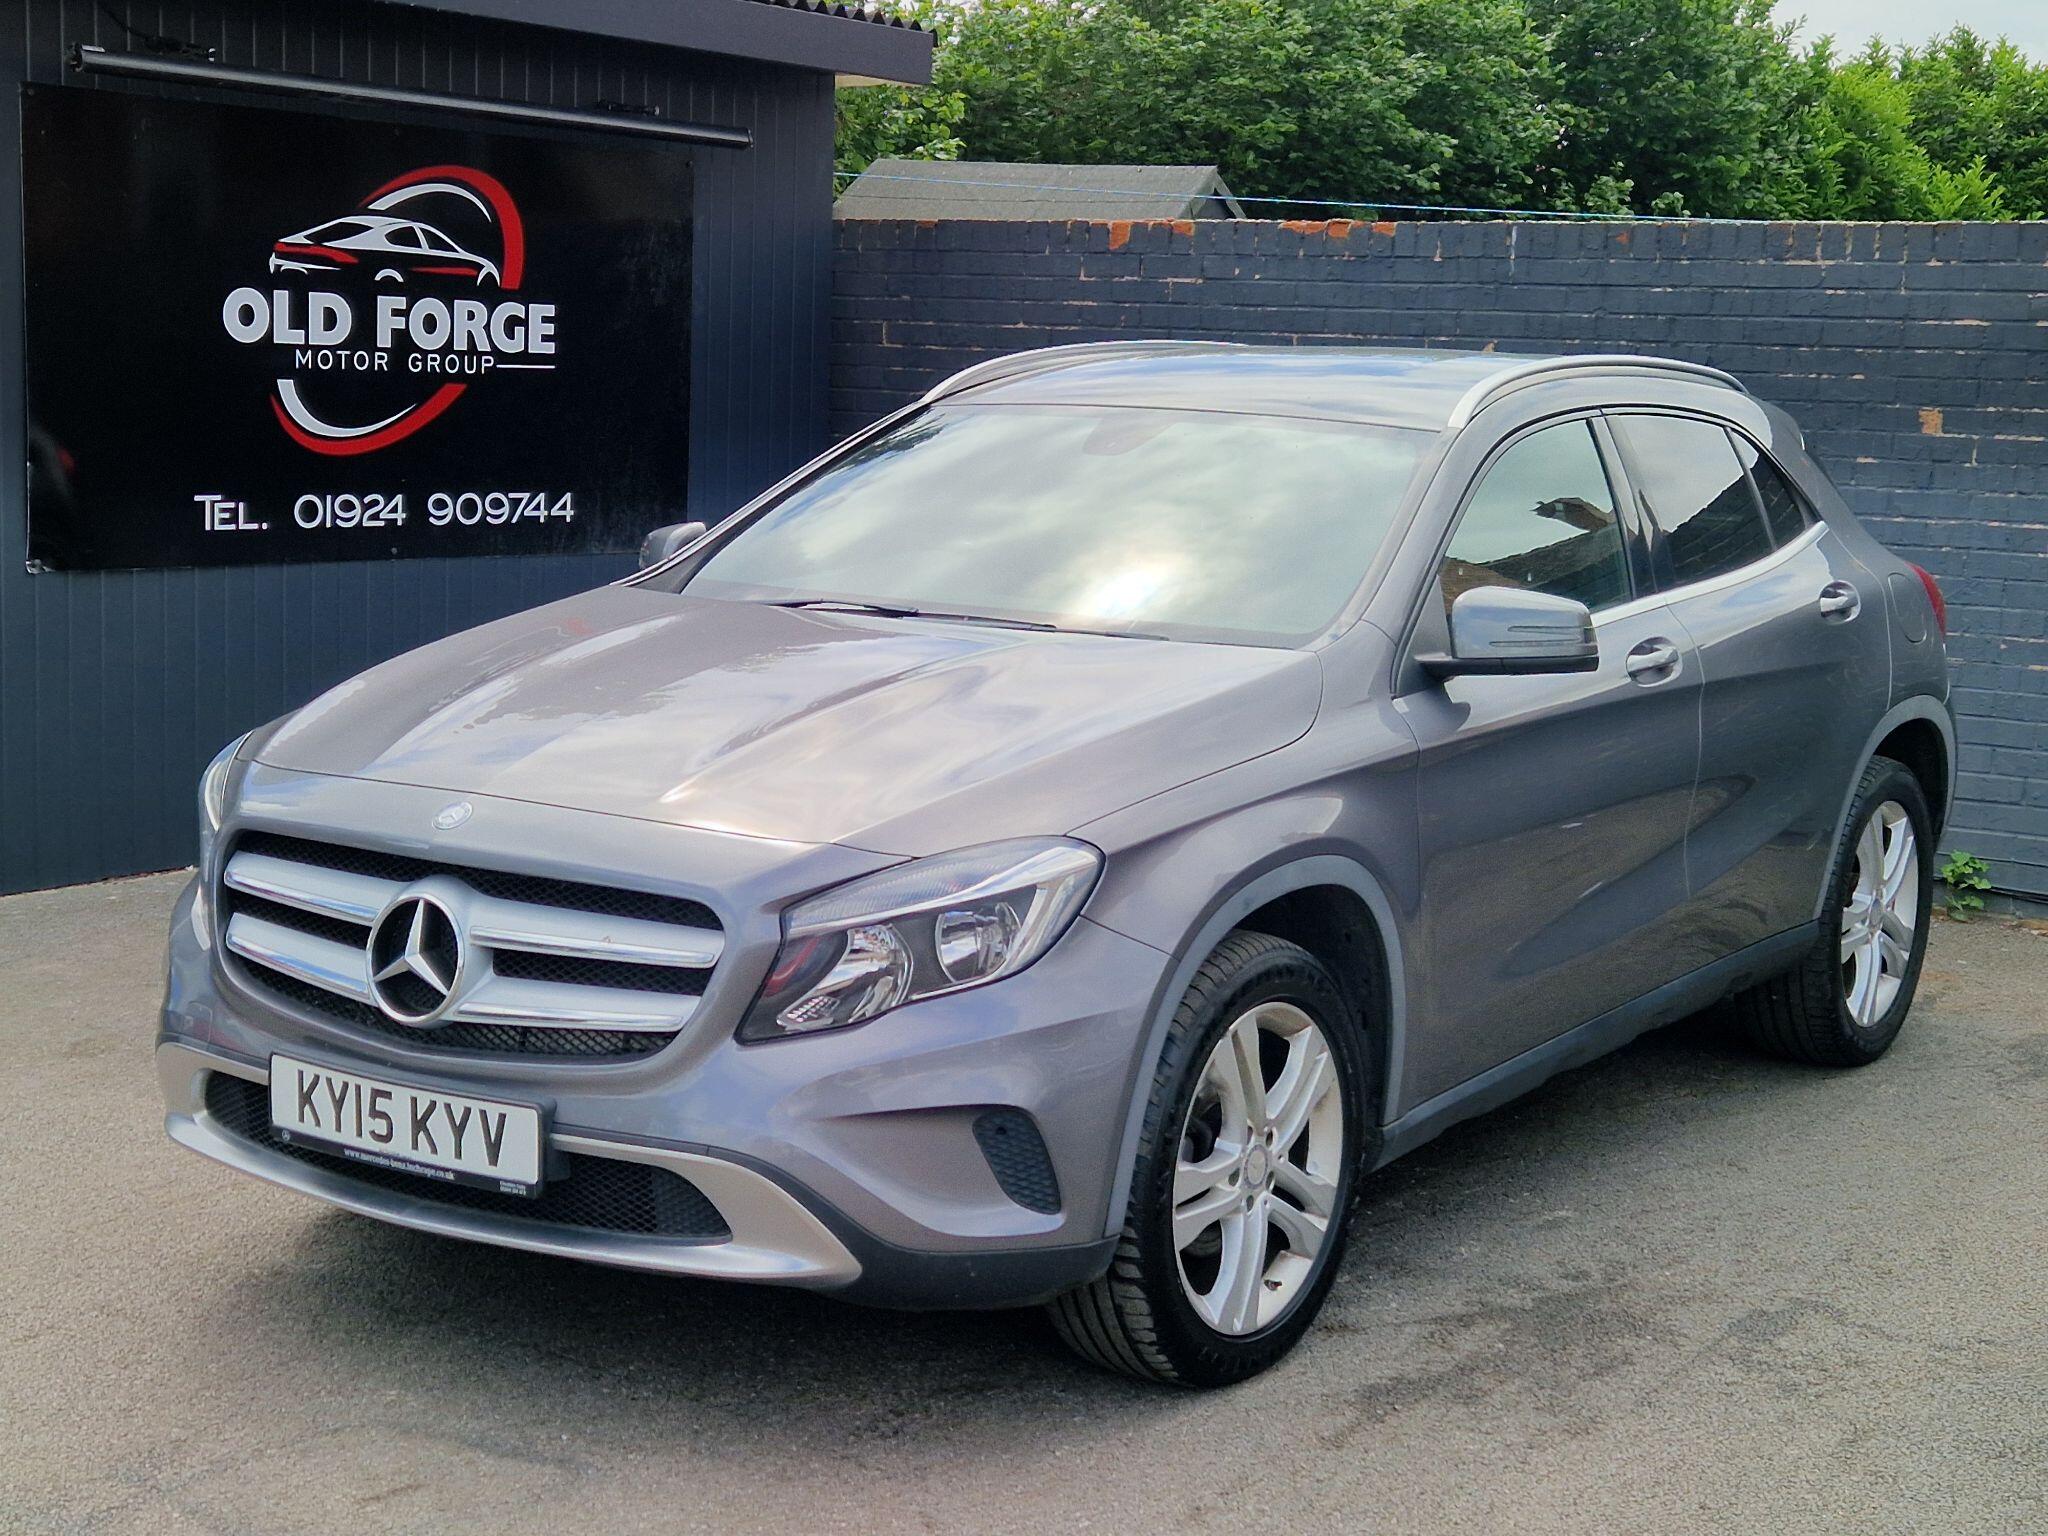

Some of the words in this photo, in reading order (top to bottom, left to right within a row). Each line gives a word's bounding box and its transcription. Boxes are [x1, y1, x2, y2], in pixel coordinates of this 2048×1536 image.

[222, 287, 352, 346] OLD
[376, 295, 556, 354] FORGE
[295, 350, 388, 371] MOTOR
[408, 354, 495, 375] GROUP
[194, 494, 268, 531] TEL.
[294, 494, 406, 529] 01924
[427, 492, 574, 526] 909744
[297, 1069, 394, 1144] KY15
[409, 1096, 507, 1168] KYV
